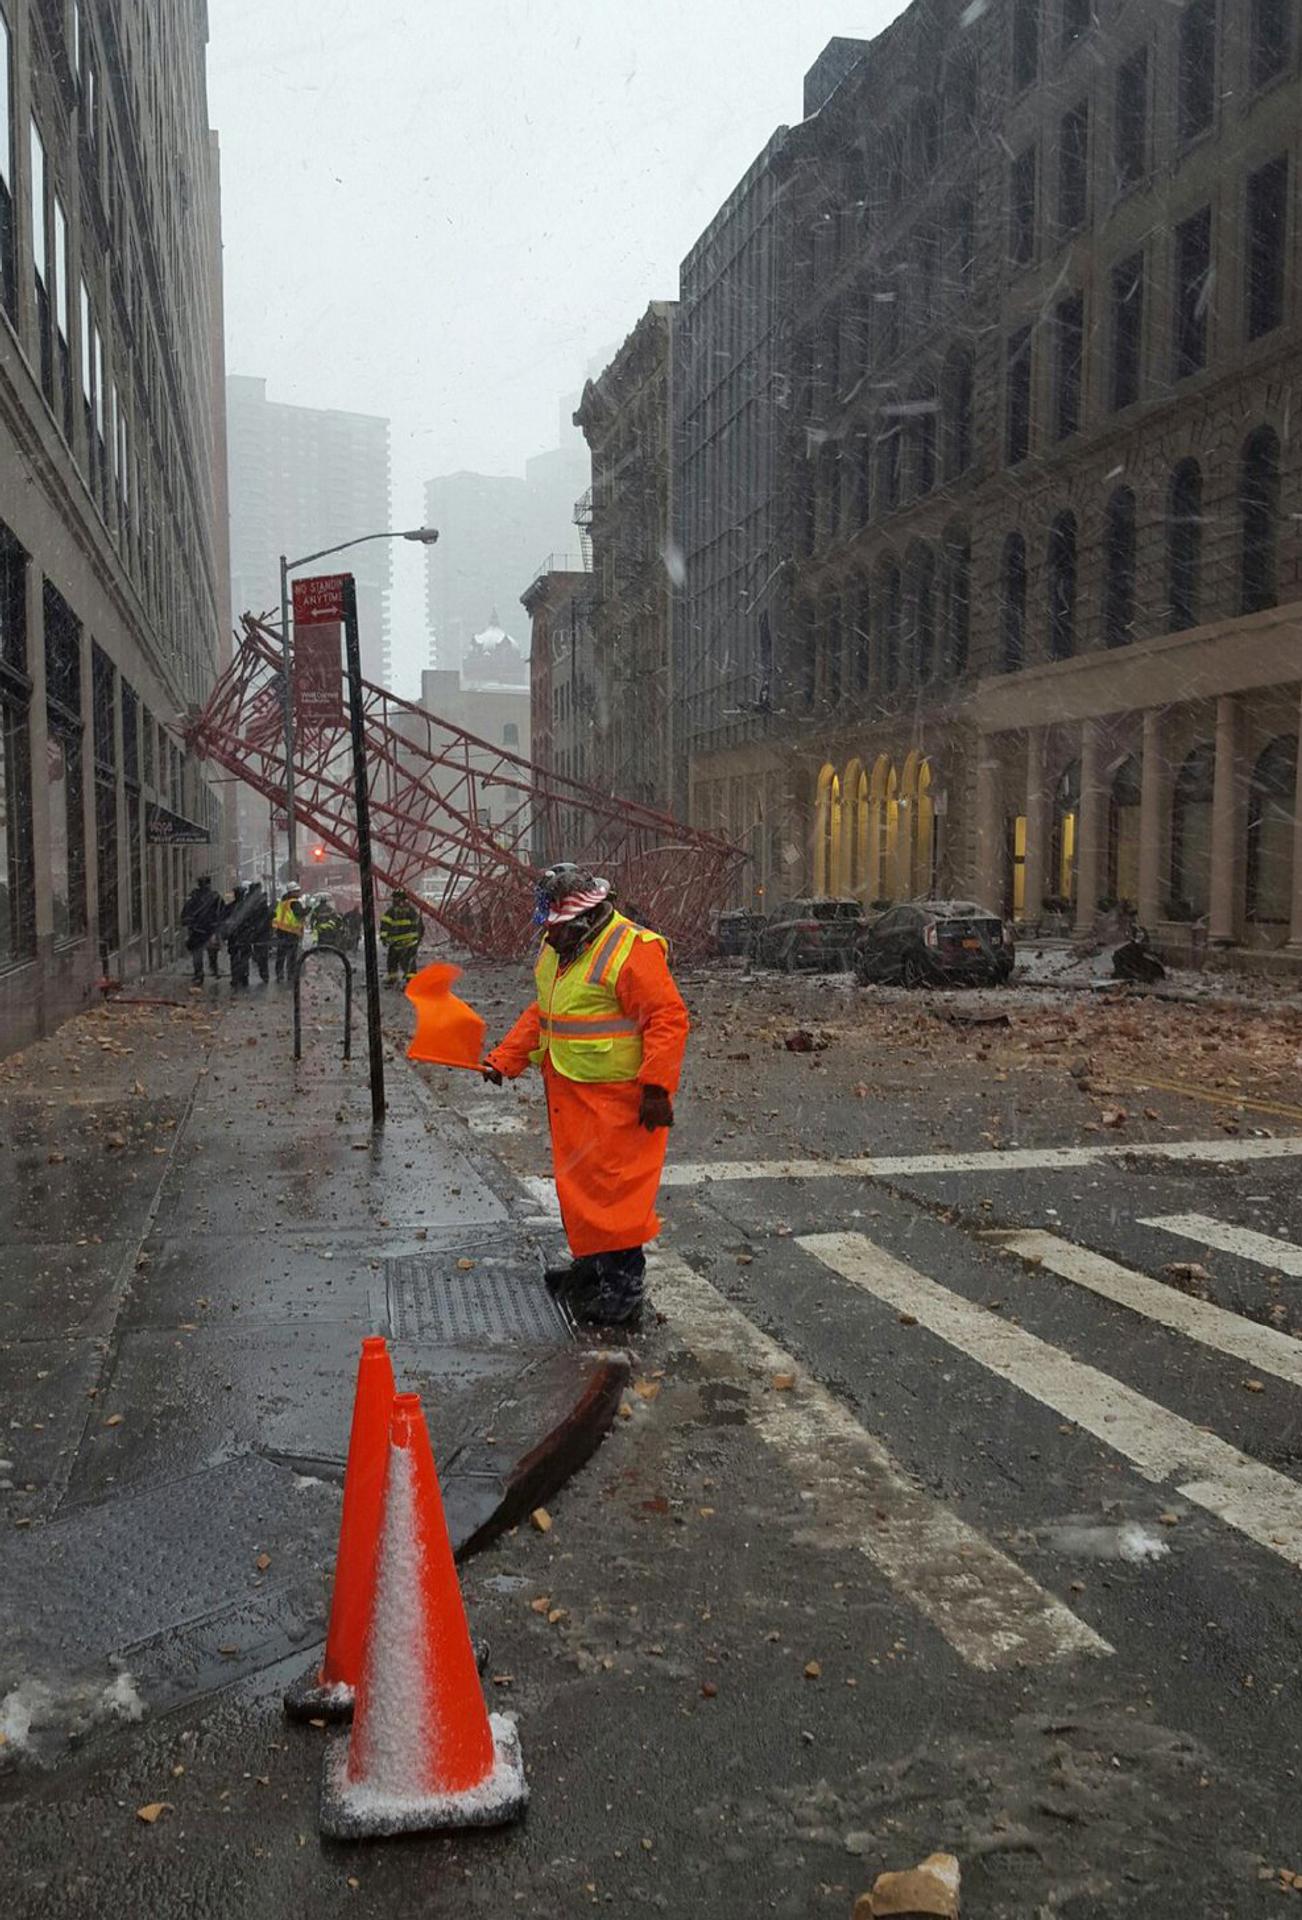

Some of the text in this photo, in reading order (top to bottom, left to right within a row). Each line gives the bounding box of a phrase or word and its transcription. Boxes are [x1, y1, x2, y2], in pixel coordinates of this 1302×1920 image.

[295, 579, 344, 595] NO STANDIN
[303, 590, 344, 606] ANYTIME
